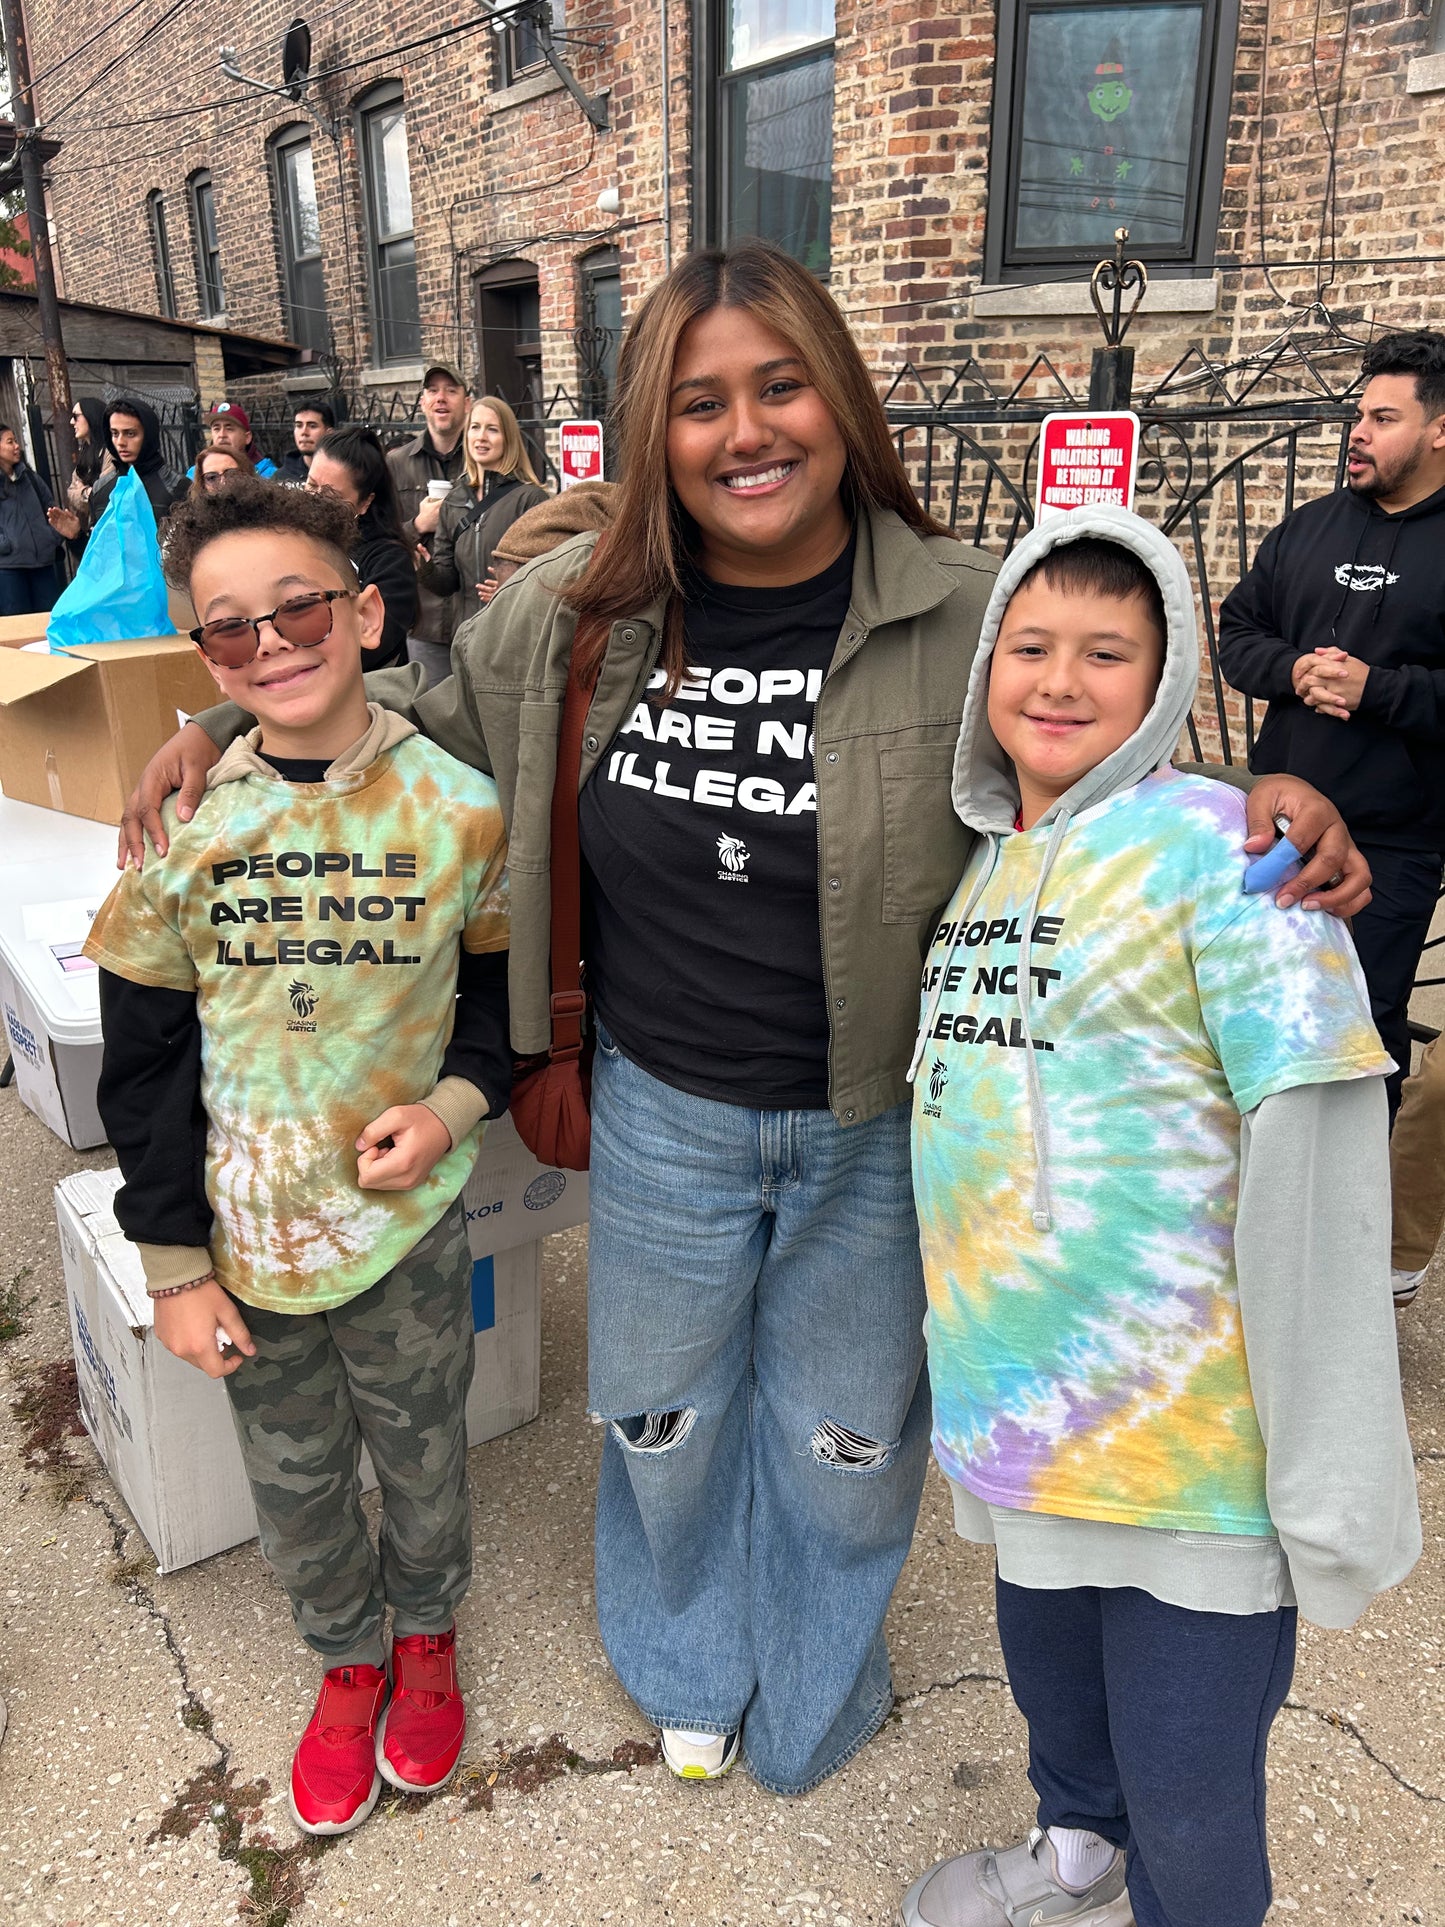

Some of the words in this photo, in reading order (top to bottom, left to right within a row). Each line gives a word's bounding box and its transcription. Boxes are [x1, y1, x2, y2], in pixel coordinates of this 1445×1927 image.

[563, 435, 599, 452] PARKING
[1066, 428, 1111, 447] WARNING
[571, 452, 591, 468] ONLY
[1050, 448, 1100, 467] VIOLATORS
[1101, 448, 1124, 467] WILL
[1056, 468, 1069, 485] BE
[1069, 468, 1102, 486] TOWED
[1101, 468, 1116, 486] AT
[1045, 486, 1083, 505] OWNERS
[1083, 488, 1124, 506] EXPENSE
[645, 666, 823, 705] PEOP
[619, 702, 736, 751] ARE
[607, 751, 818, 816] ILLEGA
[211, 851, 416, 886] PEOPLE
[210, 896, 303, 927] ARE
[318, 895, 426, 922] NOT
[215, 939, 421, 967] ILLEGAL.
[972, 965, 1062, 999] NOT
[286, 1019, 317, 1027] CHASING
[466, 1201, 504, 1222] BOX
